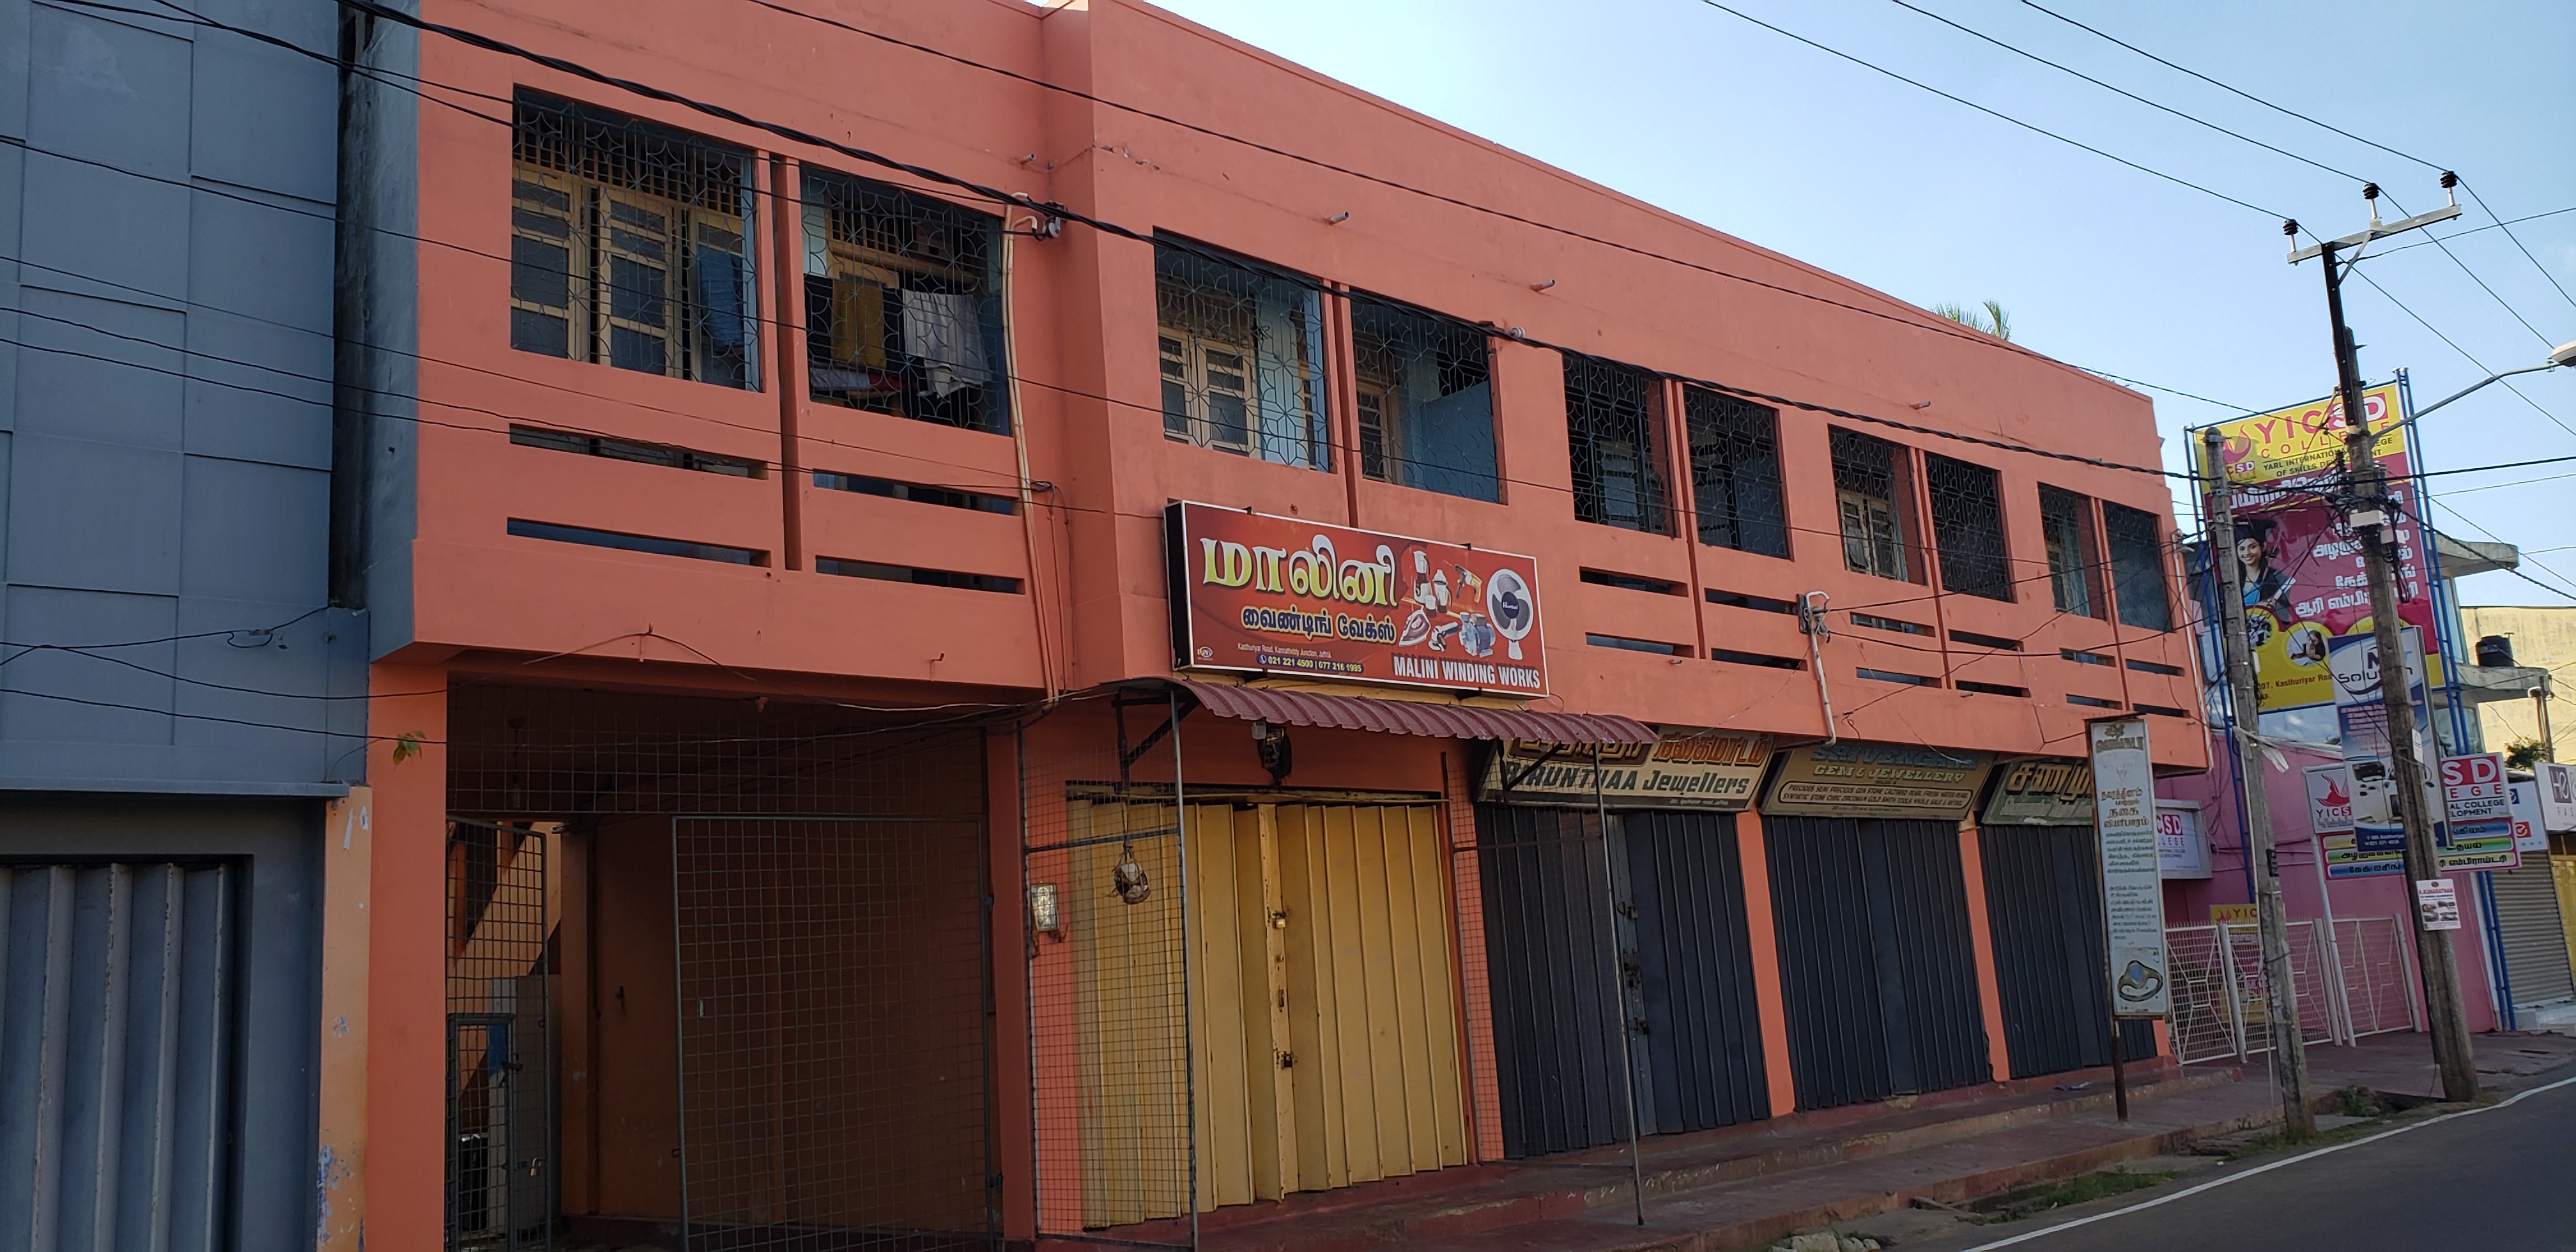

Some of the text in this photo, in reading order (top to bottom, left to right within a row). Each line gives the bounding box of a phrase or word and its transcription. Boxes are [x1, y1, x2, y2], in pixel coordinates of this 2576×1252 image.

[2260, 421, 2390, 459] COLLEE
[2263, 461, 2283, 472] YARL
[2276, 468, 2288, 477] OF
[2290, 462, 2317, 474] SKILLS
[1200, 534, 1397, 606] மாலினி
[1242, 605, 1396, 643] வைண்டிங் வேக்ஸ்
[1268, 656, 1281, 665] 021
[1282, 657, 1295, 666] 221
[1296, 659, 1314, 668] 4500
[1319, 660, 1331, 669] 077
[1393, 656, 1540, 689] MALINI WINDING WORKS
[2275, 676, 2315, 687] Kasthuriyar
[1642, 770, 1750, 794] Jewellers
[1813, 765, 1855, 777] GEM
[1867, 768, 1966, 782] JEWELLERY
[2464, 798, 2505, 809] COLLEGE
